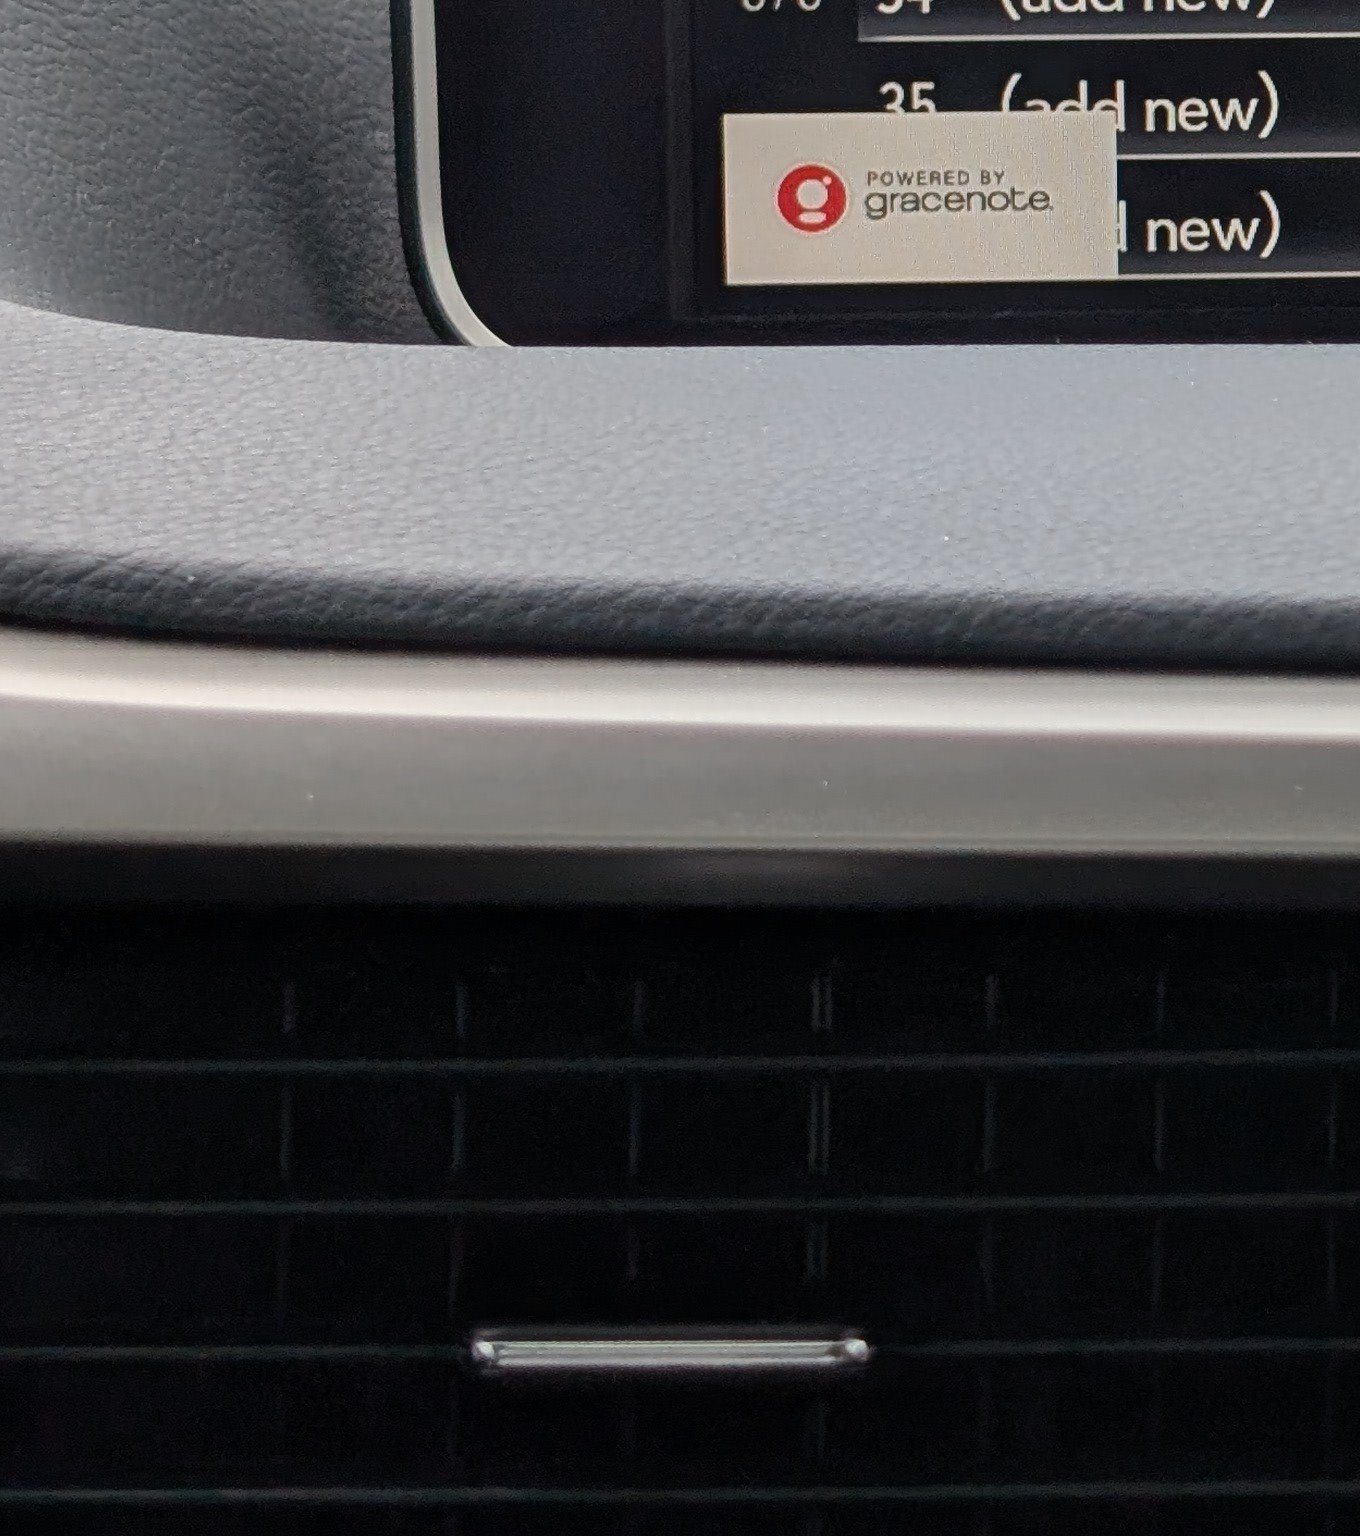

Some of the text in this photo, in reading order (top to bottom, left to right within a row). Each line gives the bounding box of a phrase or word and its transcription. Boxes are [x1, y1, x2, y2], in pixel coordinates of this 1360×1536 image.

[879, 82, 937, 113] 35
[1145, 71, 1280, 139] new)
[867, 169, 1005, 186] POWERED BY
[1147, 190, 1281, 258] new)
